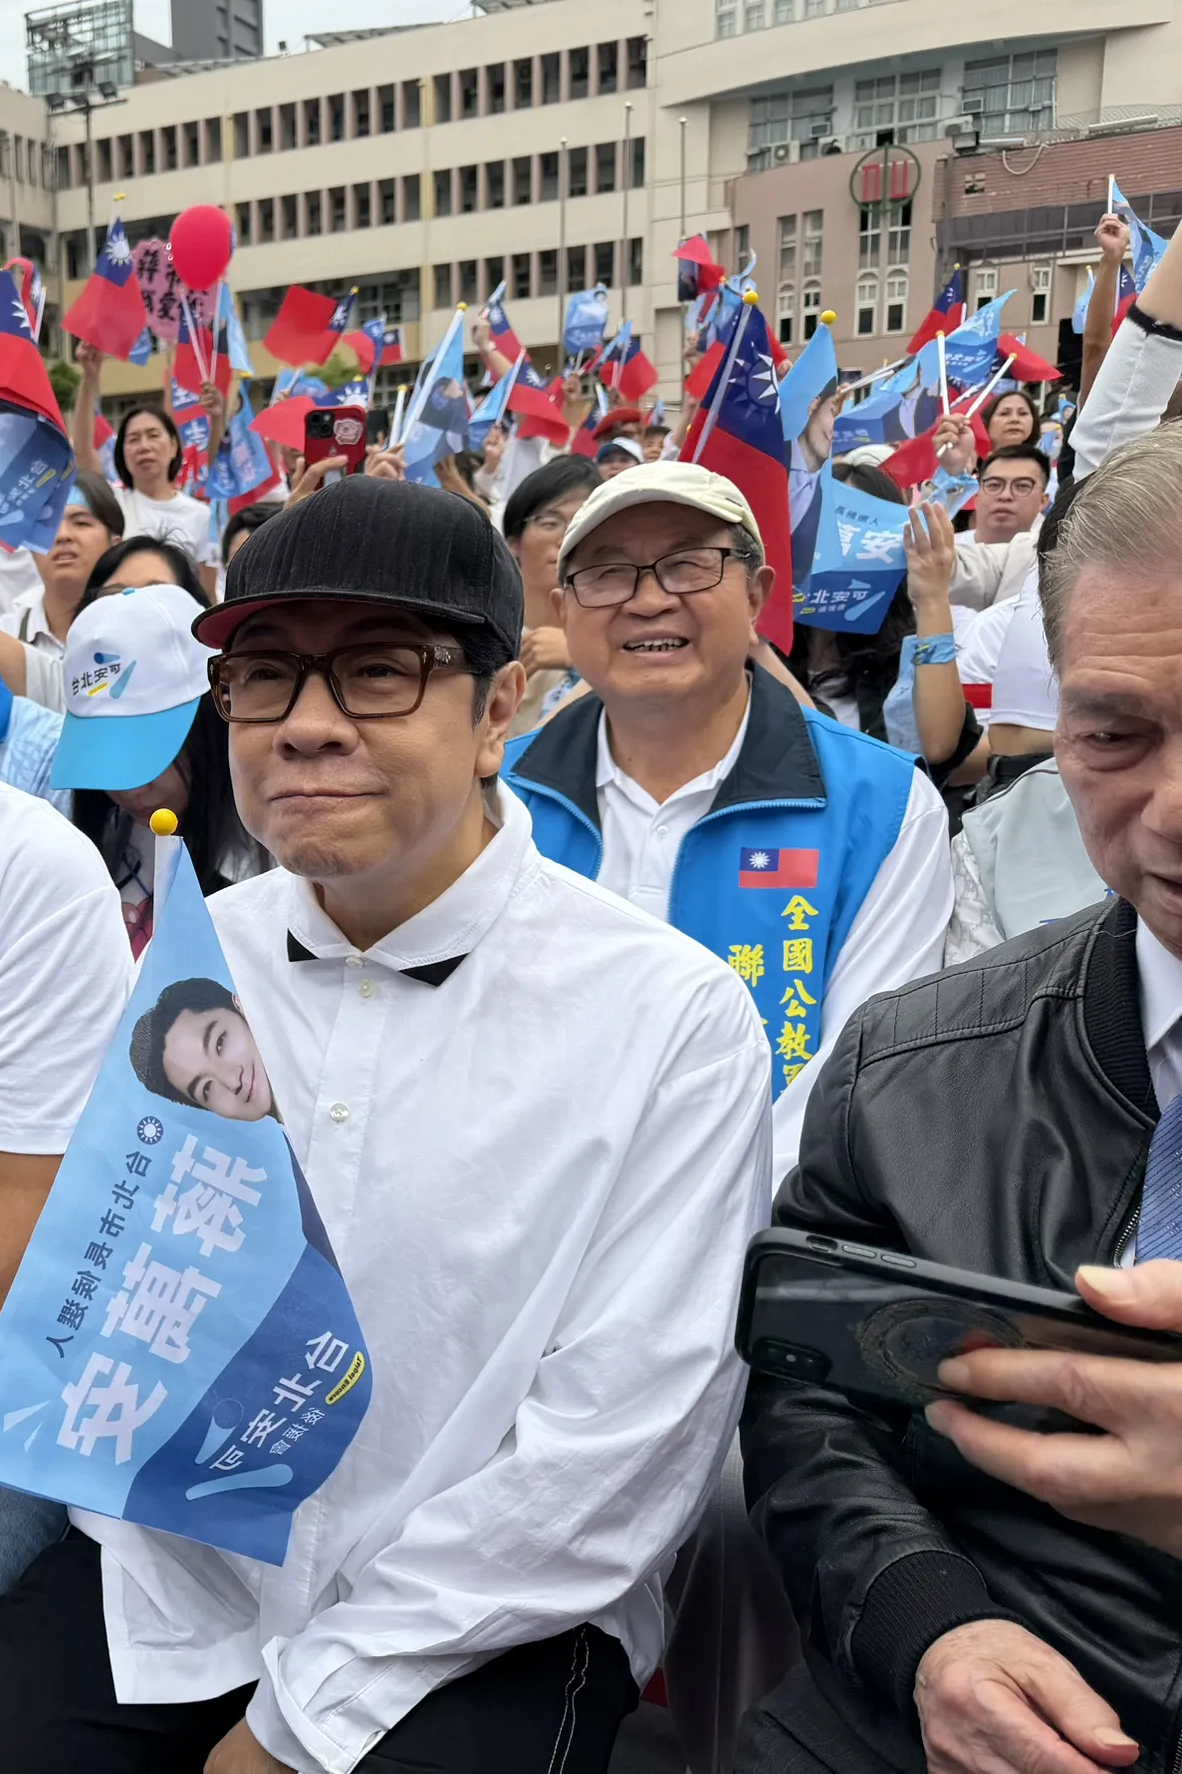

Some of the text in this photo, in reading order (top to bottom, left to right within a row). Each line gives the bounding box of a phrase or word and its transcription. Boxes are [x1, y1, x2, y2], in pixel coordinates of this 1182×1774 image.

[807, 589, 869, 604] 北安可
[72, 663, 122, 696] 台北安可
